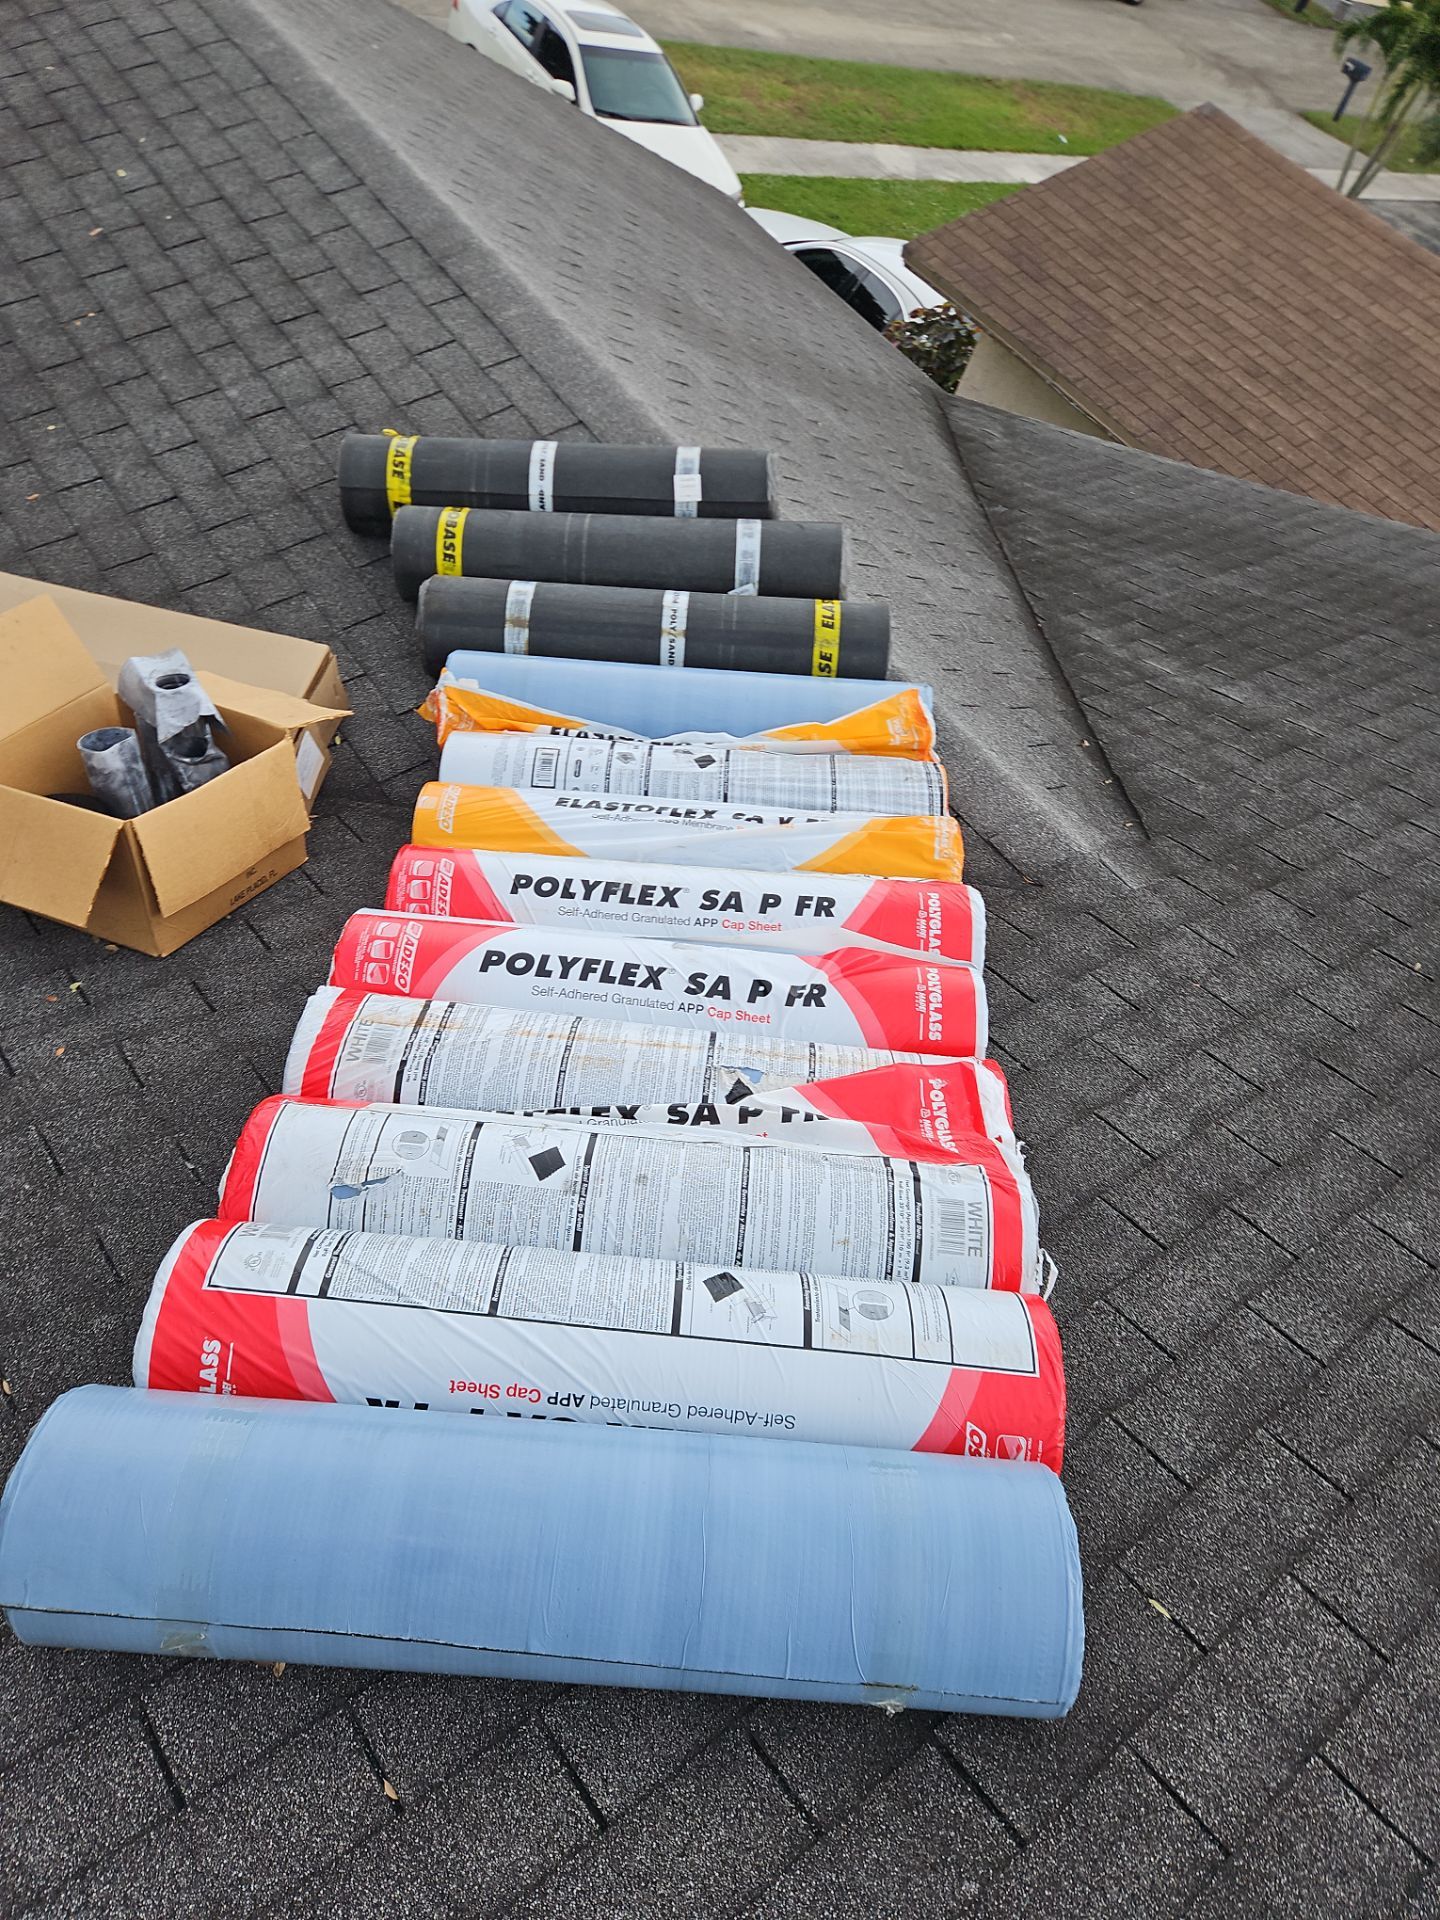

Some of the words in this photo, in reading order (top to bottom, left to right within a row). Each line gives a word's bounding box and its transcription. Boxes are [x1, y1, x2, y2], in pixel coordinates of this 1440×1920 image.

[819, 651, 832, 677] SE
[437, 876, 452, 916] ADES
[509, 874, 683, 909] POLYFLEX
[699, 890, 744, 913] SA
[758, 893, 782, 915] P
[795, 895, 836, 918] FR
[557, 905, 628, 922] Self-Adhered
[631, 911, 690, 927] Granulated
[694, 917, 718, 928] APP
[721, 918, 745, 933] Cap
[748, 919, 782, 933] Sheet
[397, 939, 415, 990] ADESO
[479, 950, 668, 991] POLYFLEX
[683, 971, 731, 1000] SA
[747, 979, 772, 1003] P
[785, 983, 828, 1008] FR
[531, 984, 609, 1003] Self-Adhered
[611, 993, 675, 1012] Granulated
[678, 1002, 705, 1016] APP
[707, 1006, 732, 1021] Cap
[735, 1010, 771, 1025] Sheet
[926, 967, 942, 1041] POLYGLASS
[346, 1019, 373, 1062] WHITE
[667, 1103, 720, 1126] SA
[967, 1201, 985, 1257] WHITE
[199, 1338, 221, 1394] LASS
[449, 1379, 501, 1400] Sheet
[505, 1383, 542, 1403] Cap
[546, 1390, 585, 1408] APP
[590, 1395, 682, 1419] Granulated
[686, 1404, 797, 1430] Self-Adhered
